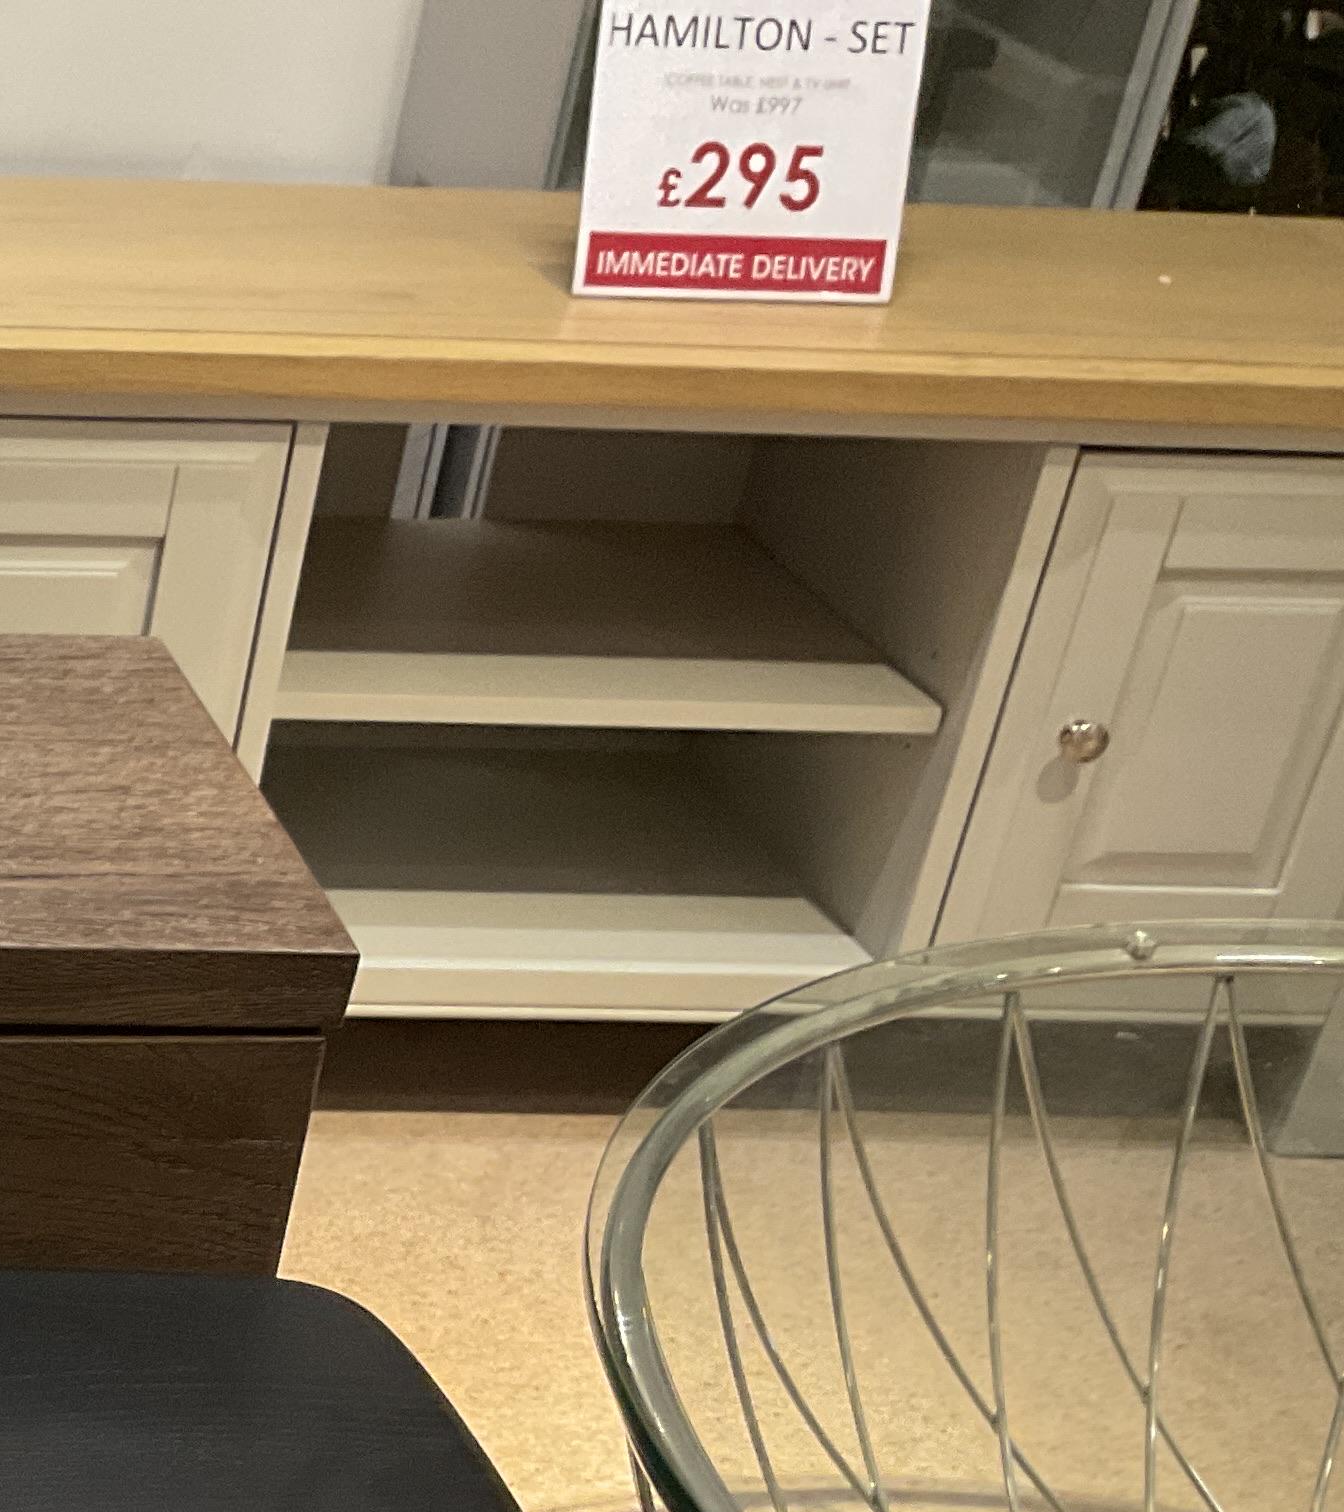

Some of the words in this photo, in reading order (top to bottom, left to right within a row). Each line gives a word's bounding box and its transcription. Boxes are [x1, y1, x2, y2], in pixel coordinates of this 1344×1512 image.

[609, 13, 812, 51] HAMILTON
[847, 20, 916, 55] SET
[711, 94, 750, 113] Was
[756, 97, 803, 114] £997
[657, 141, 825, 213] £295
[596, 251, 743, 279] IMMEDIATE
[751, 256, 876, 283] DELIVERY
